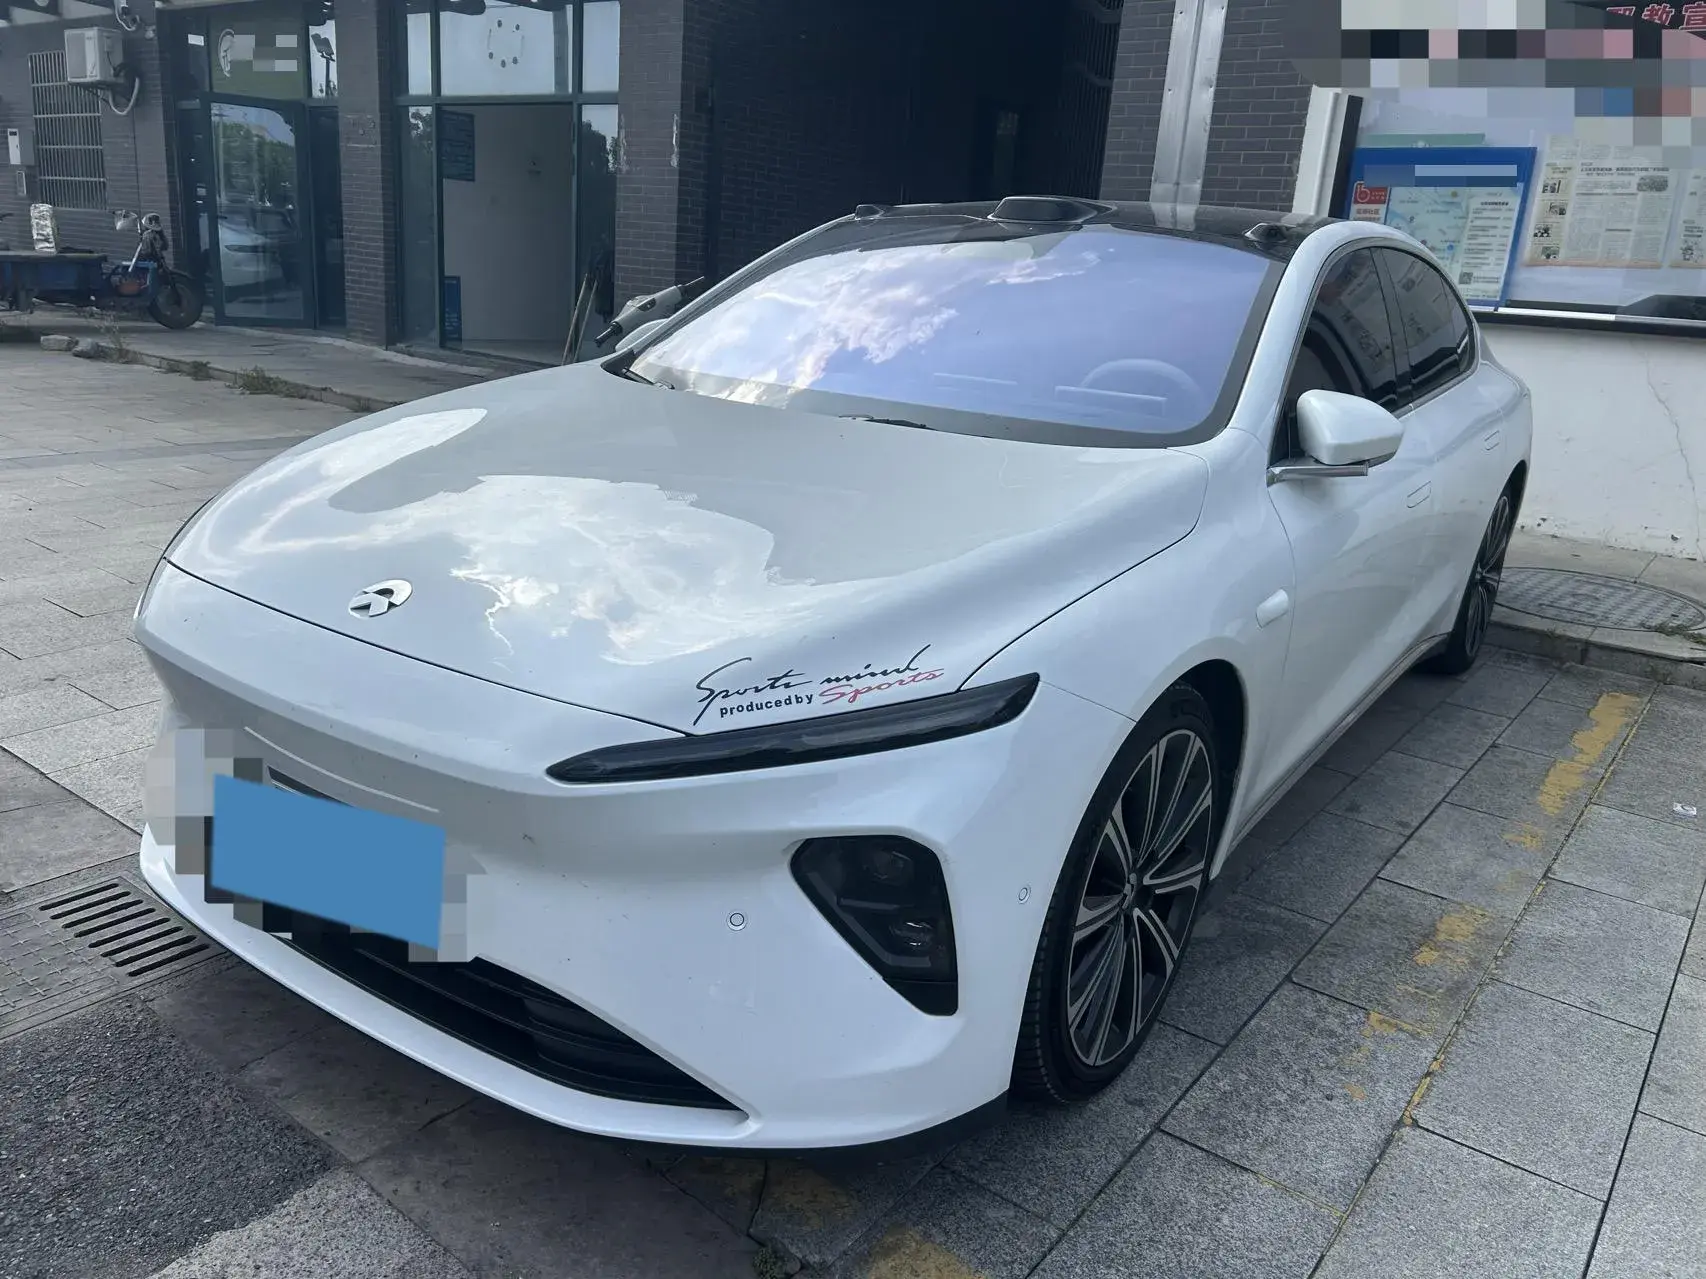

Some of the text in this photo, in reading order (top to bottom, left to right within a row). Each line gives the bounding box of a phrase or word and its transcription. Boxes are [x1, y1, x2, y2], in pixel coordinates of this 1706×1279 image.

[819, 644, 931, 685] mind
[719, 668, 945, 718] produced by Sports
